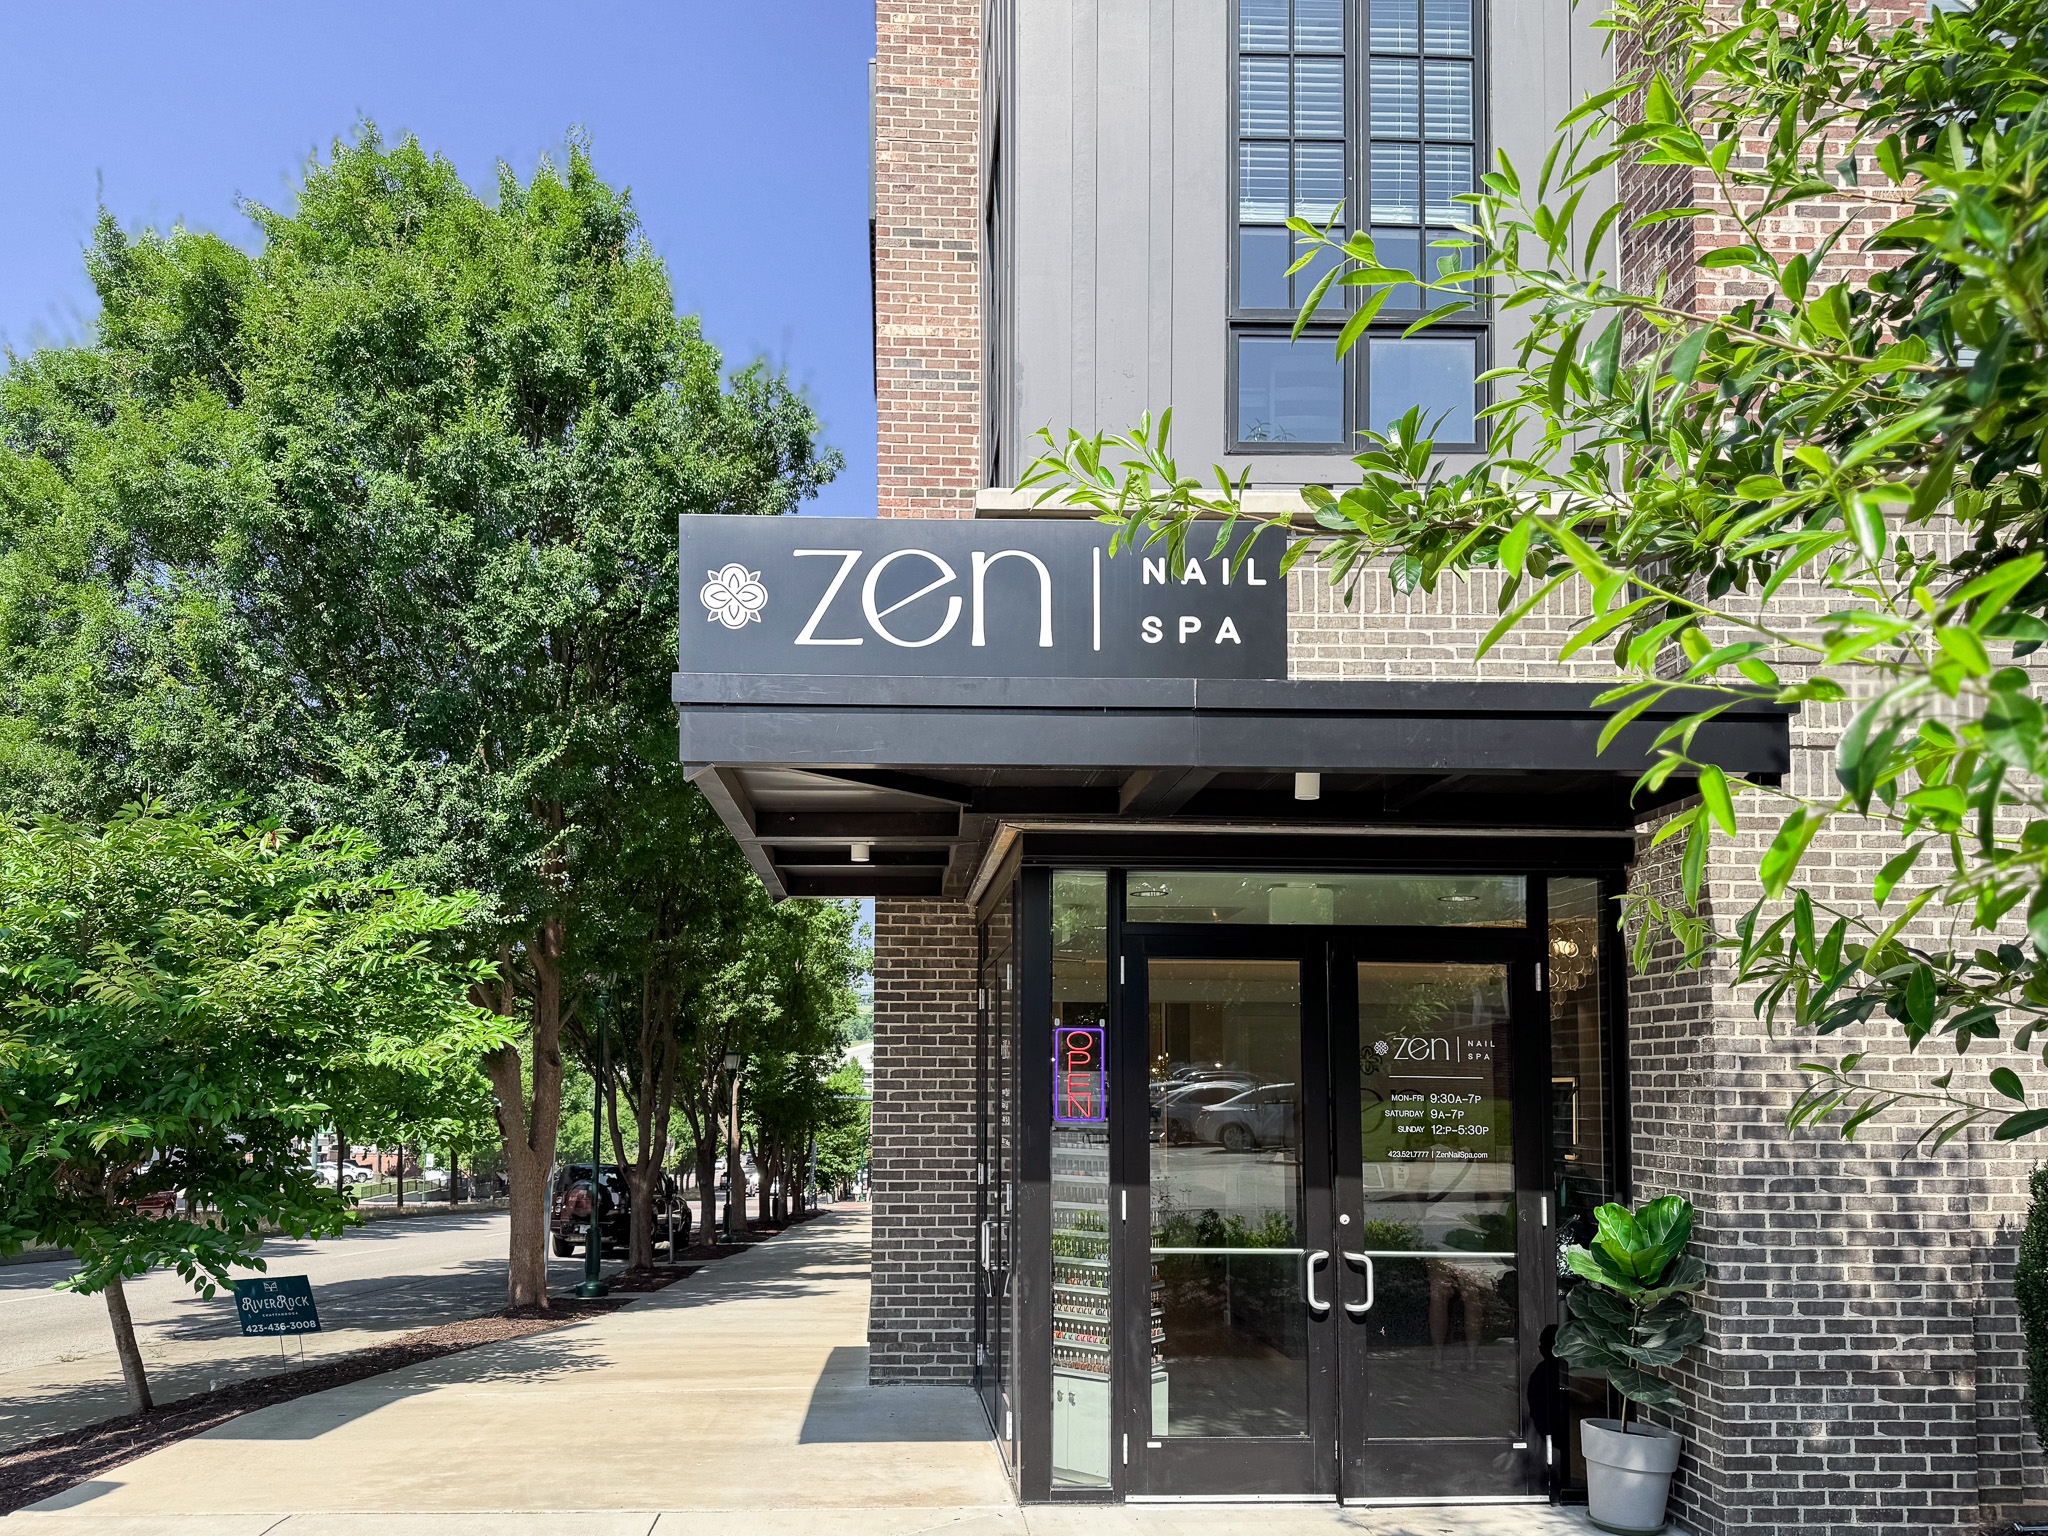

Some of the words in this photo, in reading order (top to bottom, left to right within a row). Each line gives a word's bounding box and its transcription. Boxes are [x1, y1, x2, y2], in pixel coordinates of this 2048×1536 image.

[1142, 556, 1267, 586] NAIL
[793, 548, 1053, 648] zen
[1141, 615, 1242, 644] SPA
[1393, 1037, 1450, 1060] zen
[1467, 1040, 1496, 1048] NAIL
[1066, 1031, 1093, 1118] OPEN
[1391, 1094, 1425, 1102] MON-FRI
[1384, 1110, 1425, 1118] SATURDAY
[1436, 1151, 1488, 1160] ZenNailSpa.com
[246, 1320, 316, 1333] 423-436-3008
